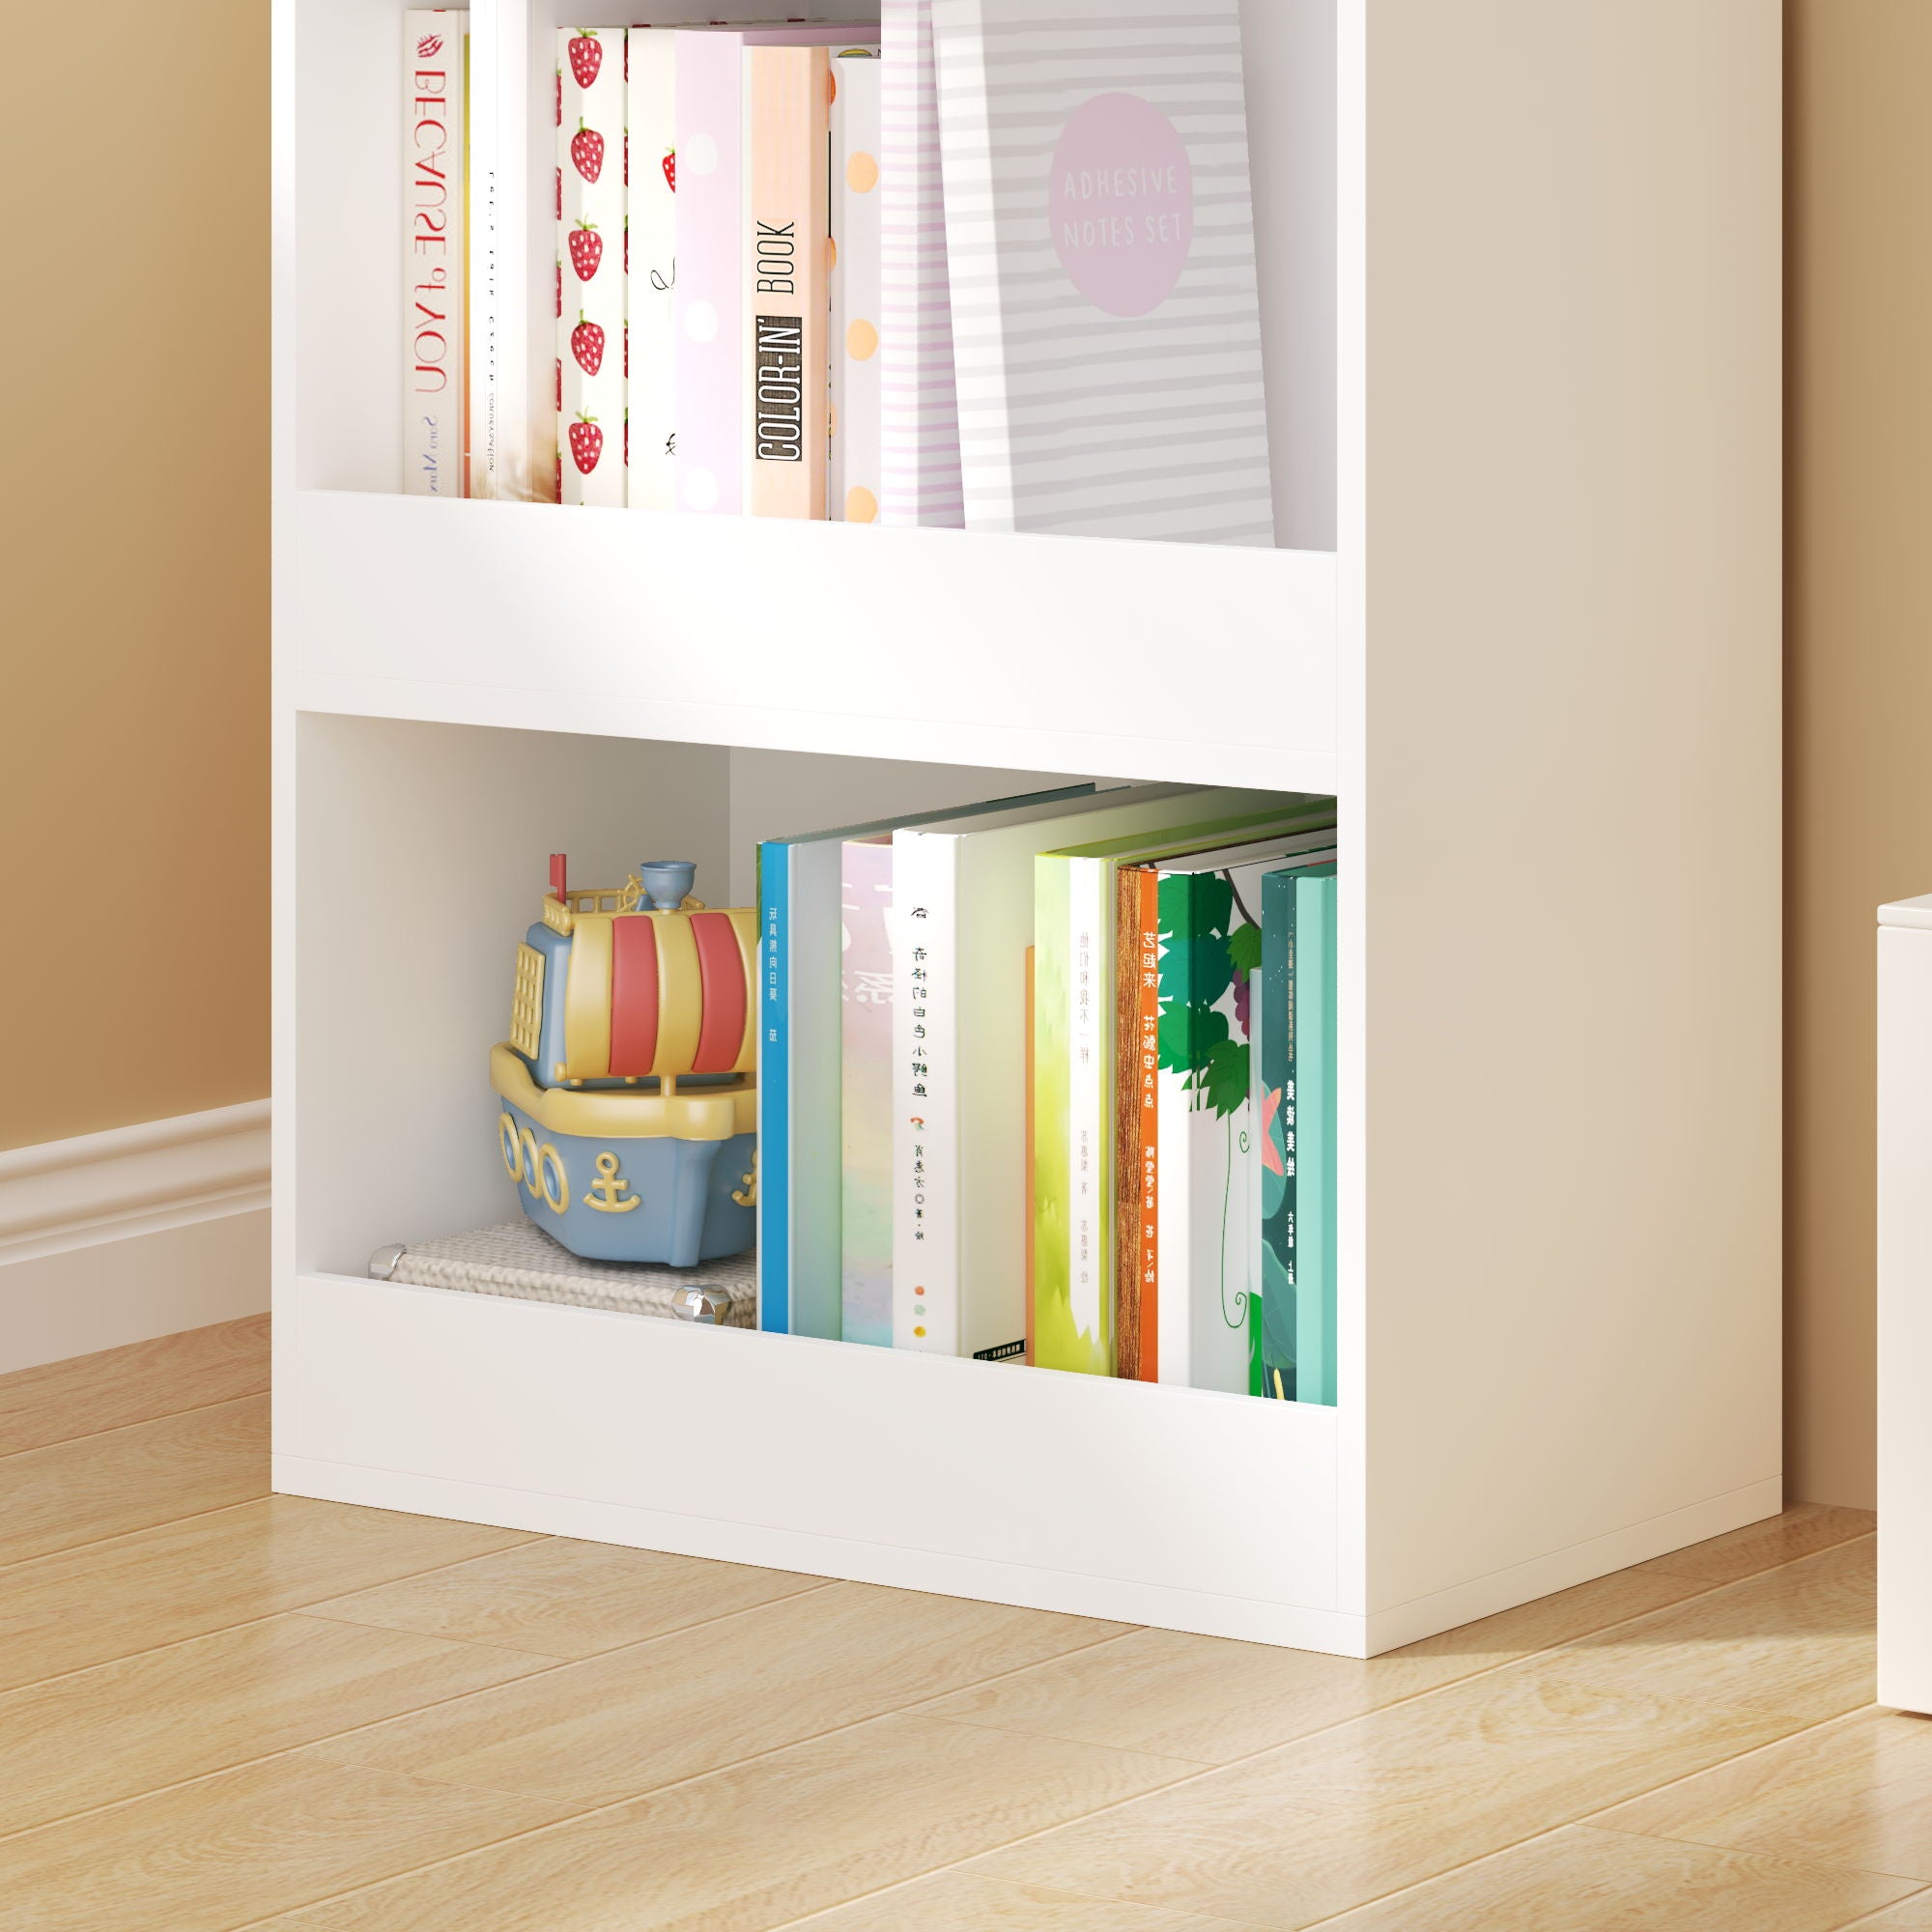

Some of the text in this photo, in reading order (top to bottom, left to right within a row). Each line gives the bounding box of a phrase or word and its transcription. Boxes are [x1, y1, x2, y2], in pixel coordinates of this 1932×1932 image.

[1065, 165, 1178, 200] ADHESIVE
[1064, 213, 1181, 248] NOTES SET
[756, 220, 795, 295] BOOK
